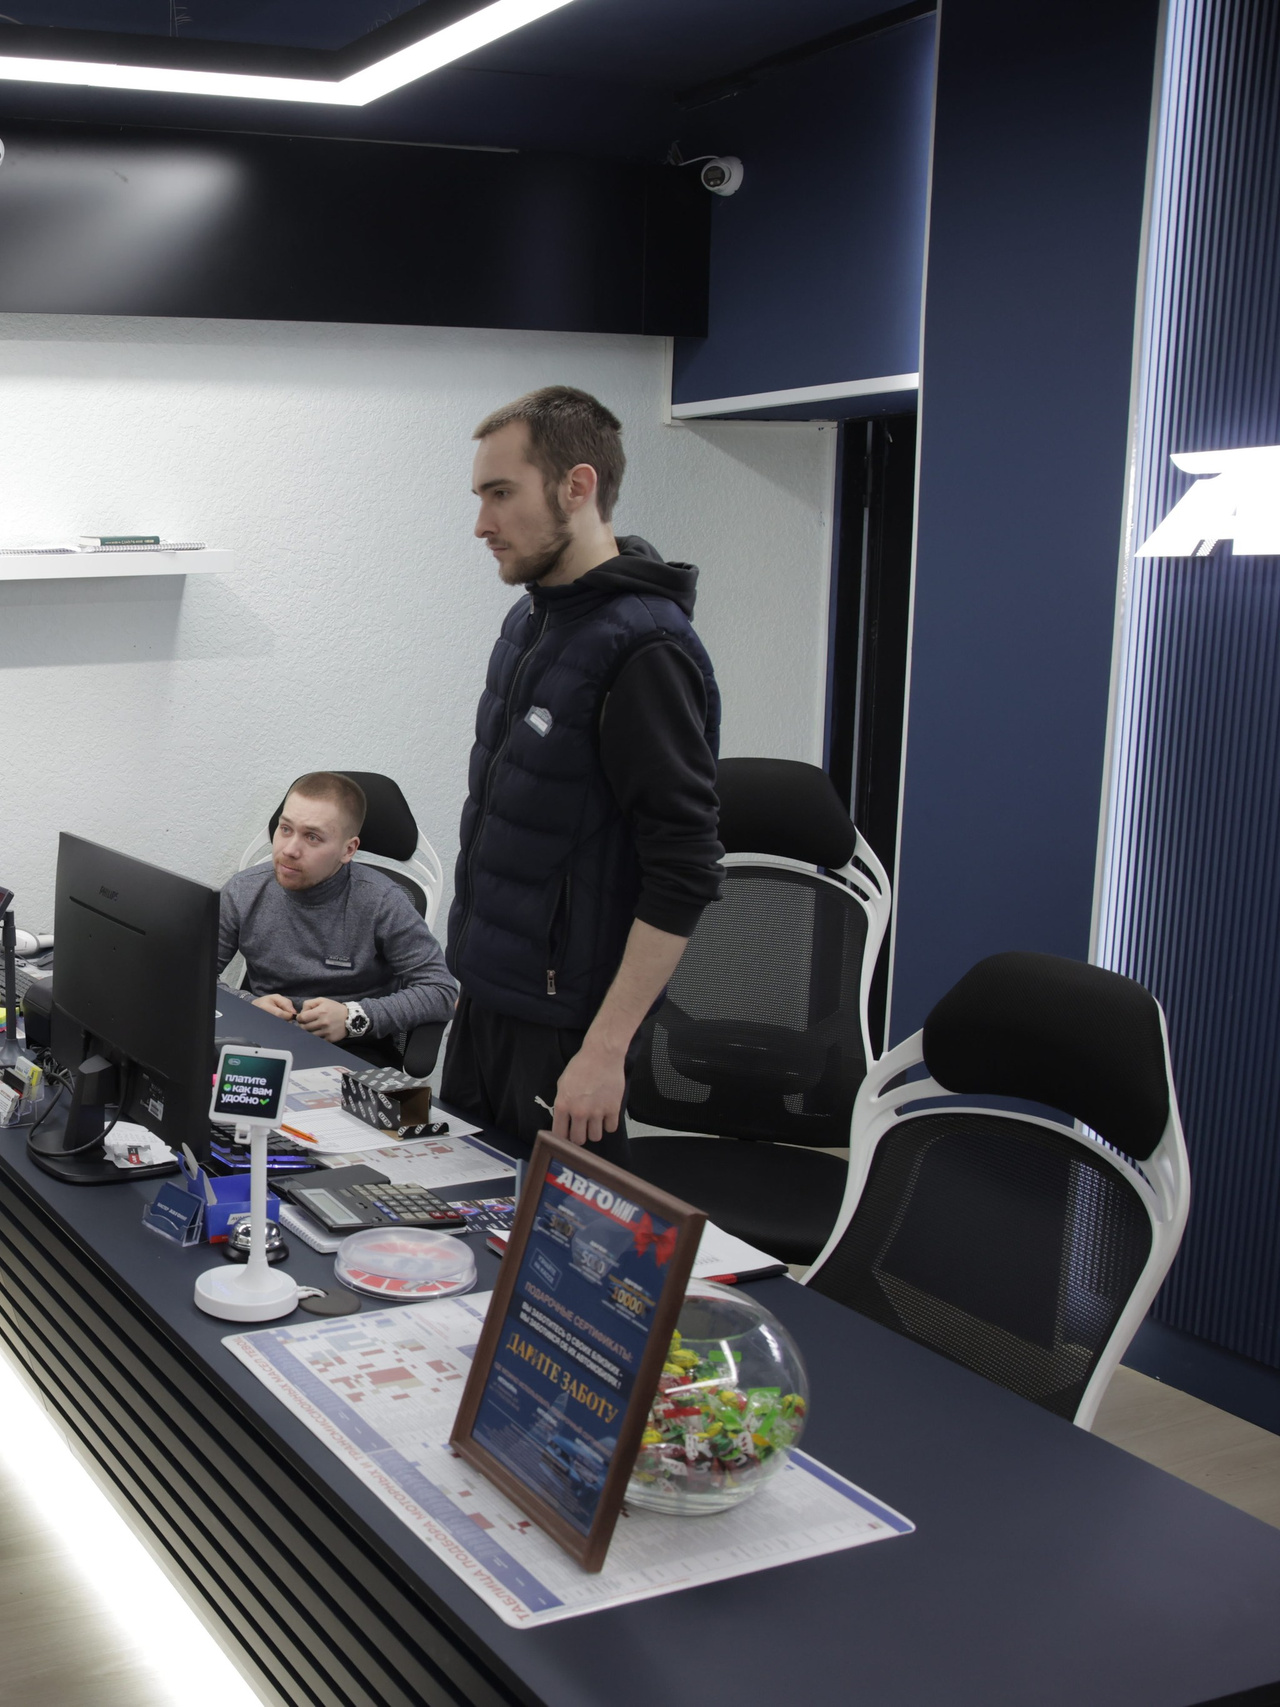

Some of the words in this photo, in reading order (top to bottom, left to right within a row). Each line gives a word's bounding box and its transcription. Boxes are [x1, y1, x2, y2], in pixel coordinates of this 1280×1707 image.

[221, 1093, 259, 1105] удобно
[225, 1074, 267, 1086] платите
[232, 1084, 251, 1094] как
[252, 1086, 273, 1096] вам
[555, 1166, 639, 1224] АВТОМИГ
[524, 1281, 574, 1322] ПОДАРОЧНЫЕ
[531, 1306, 566, 1339] ЗАБОТИТЕСЬ
[571, 1336, 592, 1356] СВОИХ
[254, 1357, 283, 1384] МАСЕЛ
[506, 1332, 562, 1384] ДАРИТЕ
[560, 1371, 619, 1424] ЗАБОТУ
[280, 1380, 364, 1461] ТРАНСМИССИОННЫХ
[370, 1469, 426, 1521] МОТОРНЫХ
[423, 1520, 475, 1569] ПОДБОРА
[473, 1569, 531, 1622] ТАБЛИЦА
